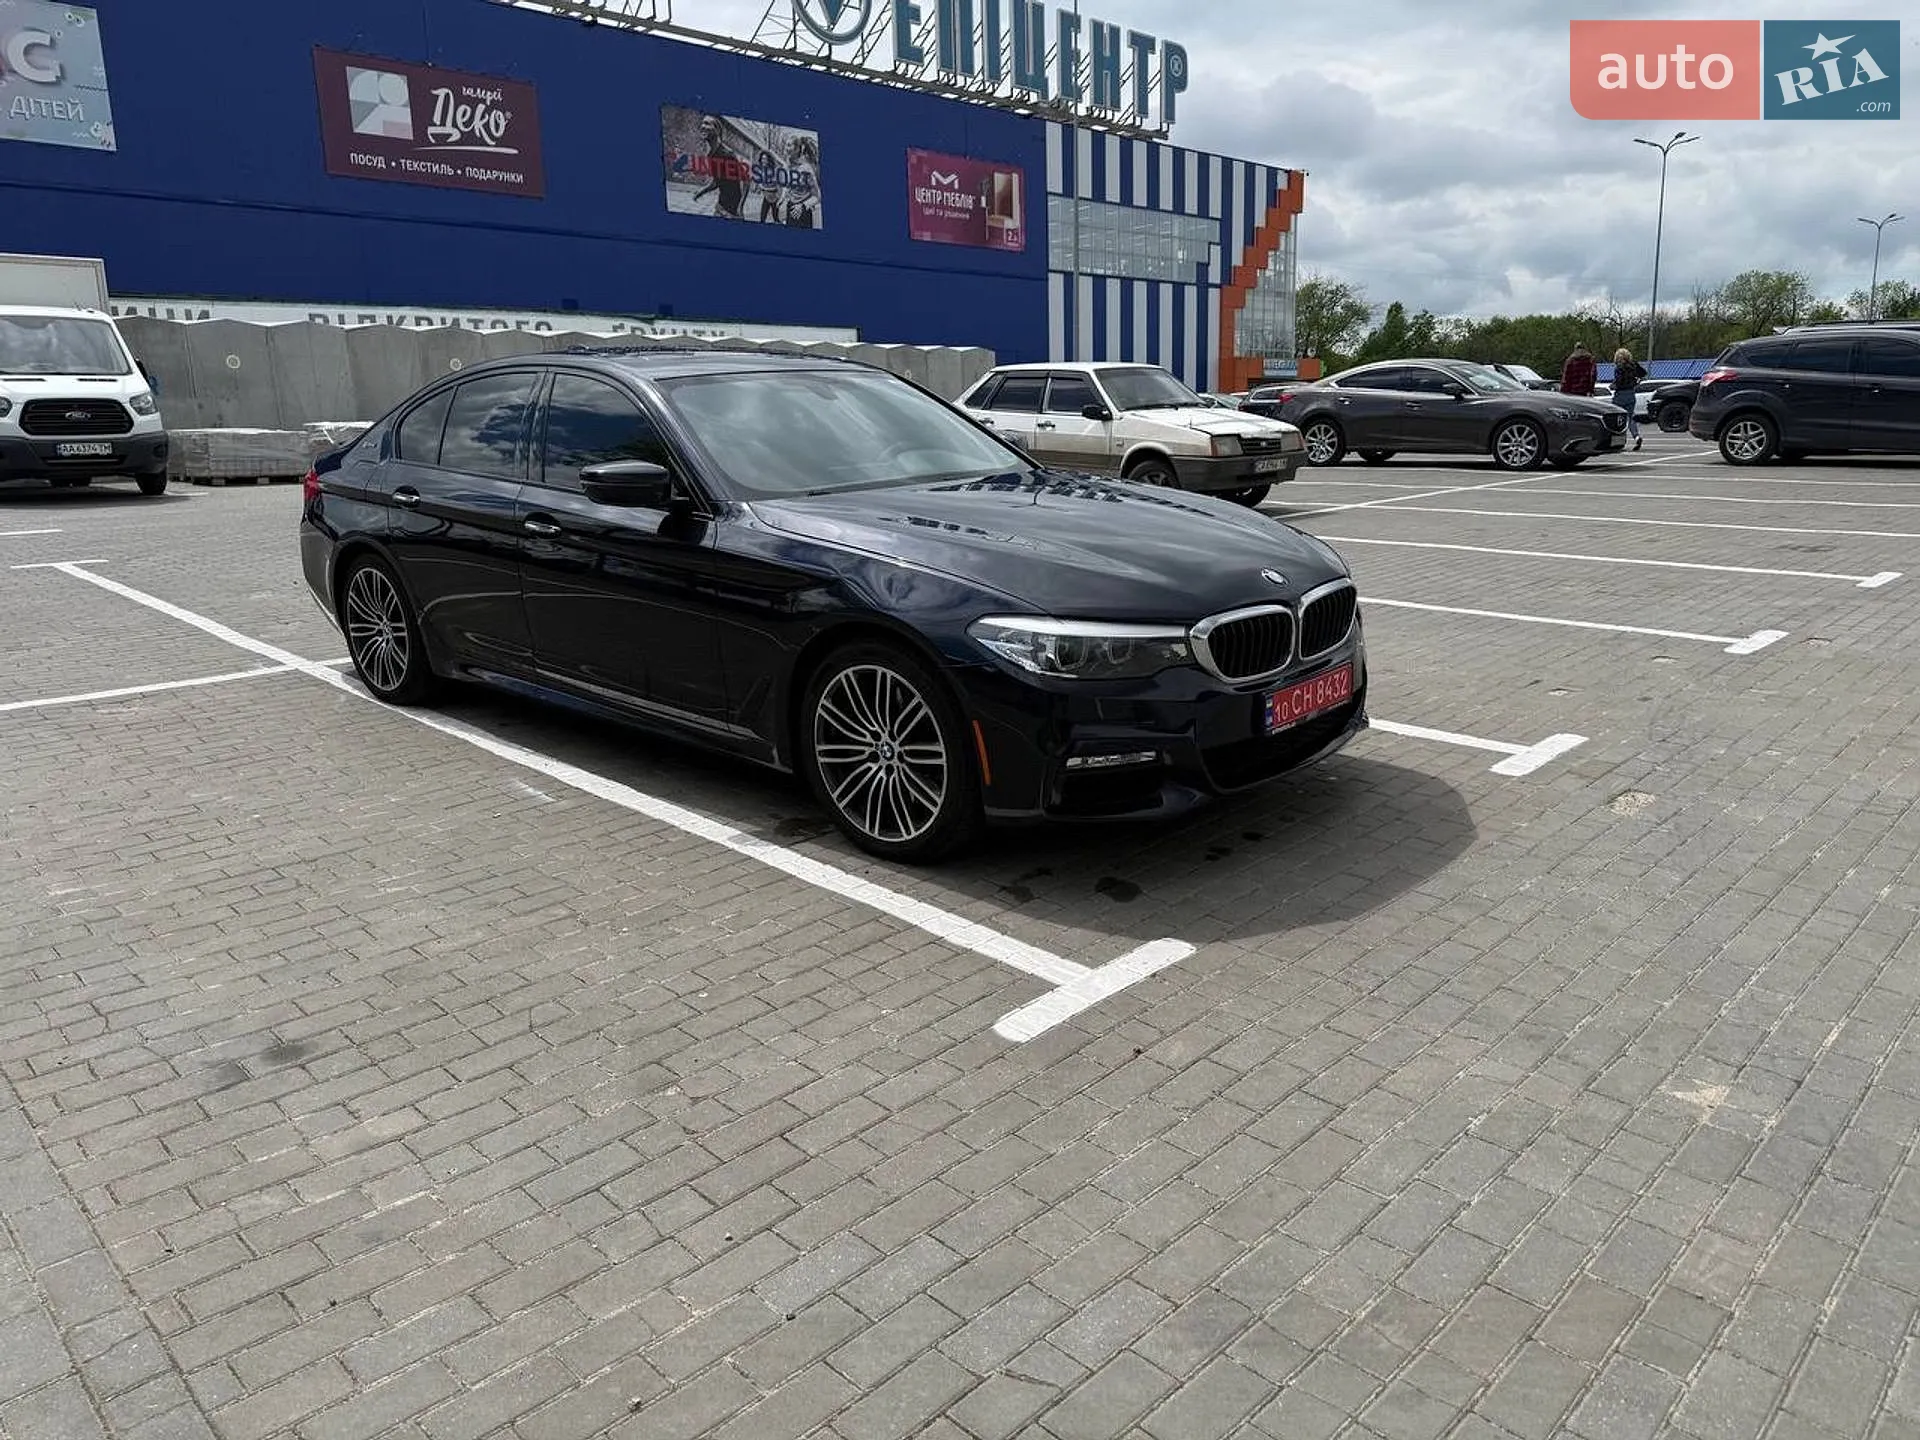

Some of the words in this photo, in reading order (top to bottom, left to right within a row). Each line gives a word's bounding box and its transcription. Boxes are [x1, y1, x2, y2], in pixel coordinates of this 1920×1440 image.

[9, 95, 84, 121] ДІТЕЙ
[427, 87, 508, 145] Деко
[350, 152, 387, 169] ПОСУД
[400, 158, 454, 176] ТЕКСТИЛЬ
[466, 166, 524, 184] ПОДАРУНКИ
[691, 154, 812, 188] INTERSPORT
[915, 186, 942, 205] ЦЕНТР
[1317, 669, 1349, 704] 8432
